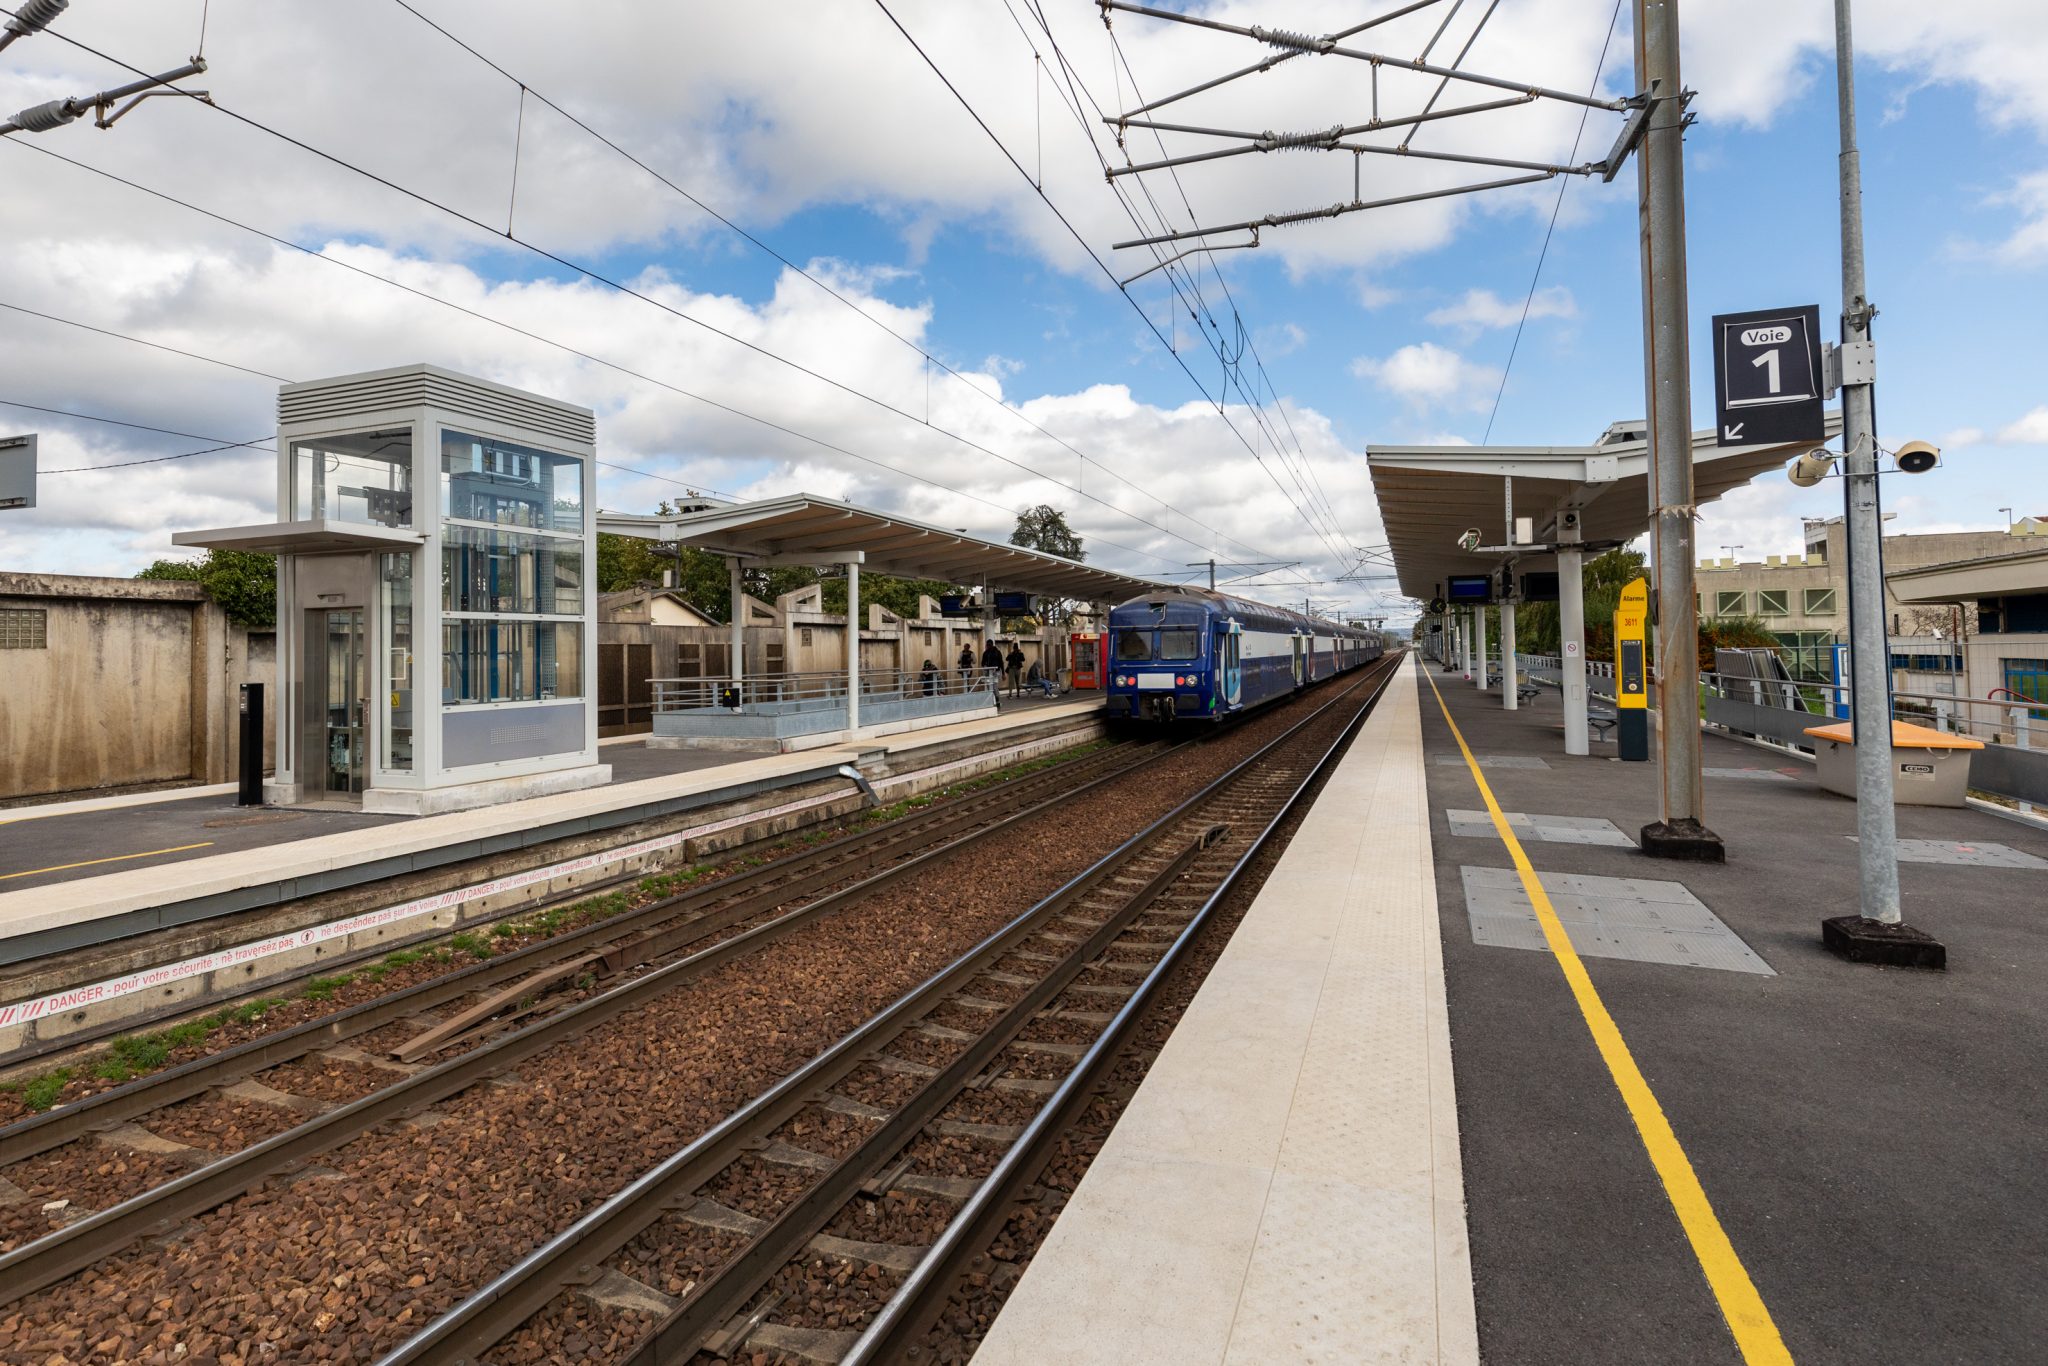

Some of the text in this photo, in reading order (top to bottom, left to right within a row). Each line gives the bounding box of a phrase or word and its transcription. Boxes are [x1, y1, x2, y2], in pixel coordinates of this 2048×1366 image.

[1747, 330, 1784, 343] Voie
[1752, 349, 1780, 394] 1
[468, 883, 495, 898] DANGER
[499, 880, 513, 890] pour
[50, 986, 103, 1011] DANGER
[113, 976, 140, 995] pour
[142, 970, 169, 985] votre
[172, 956, 213, 977] sécurité
[221, 954, 233, 965] ne
[235, 941, 277, 960] traversez
[278, 936, 294, 951] pas
[321, 926, 332, 937] ne
[333, 915, 377, 933] descendez
[378, 911, 392, 924] pas
[393, 907, 406, 918] sur
[407, 904, 418, 914] les
[419, 898, 438, 910] voies
